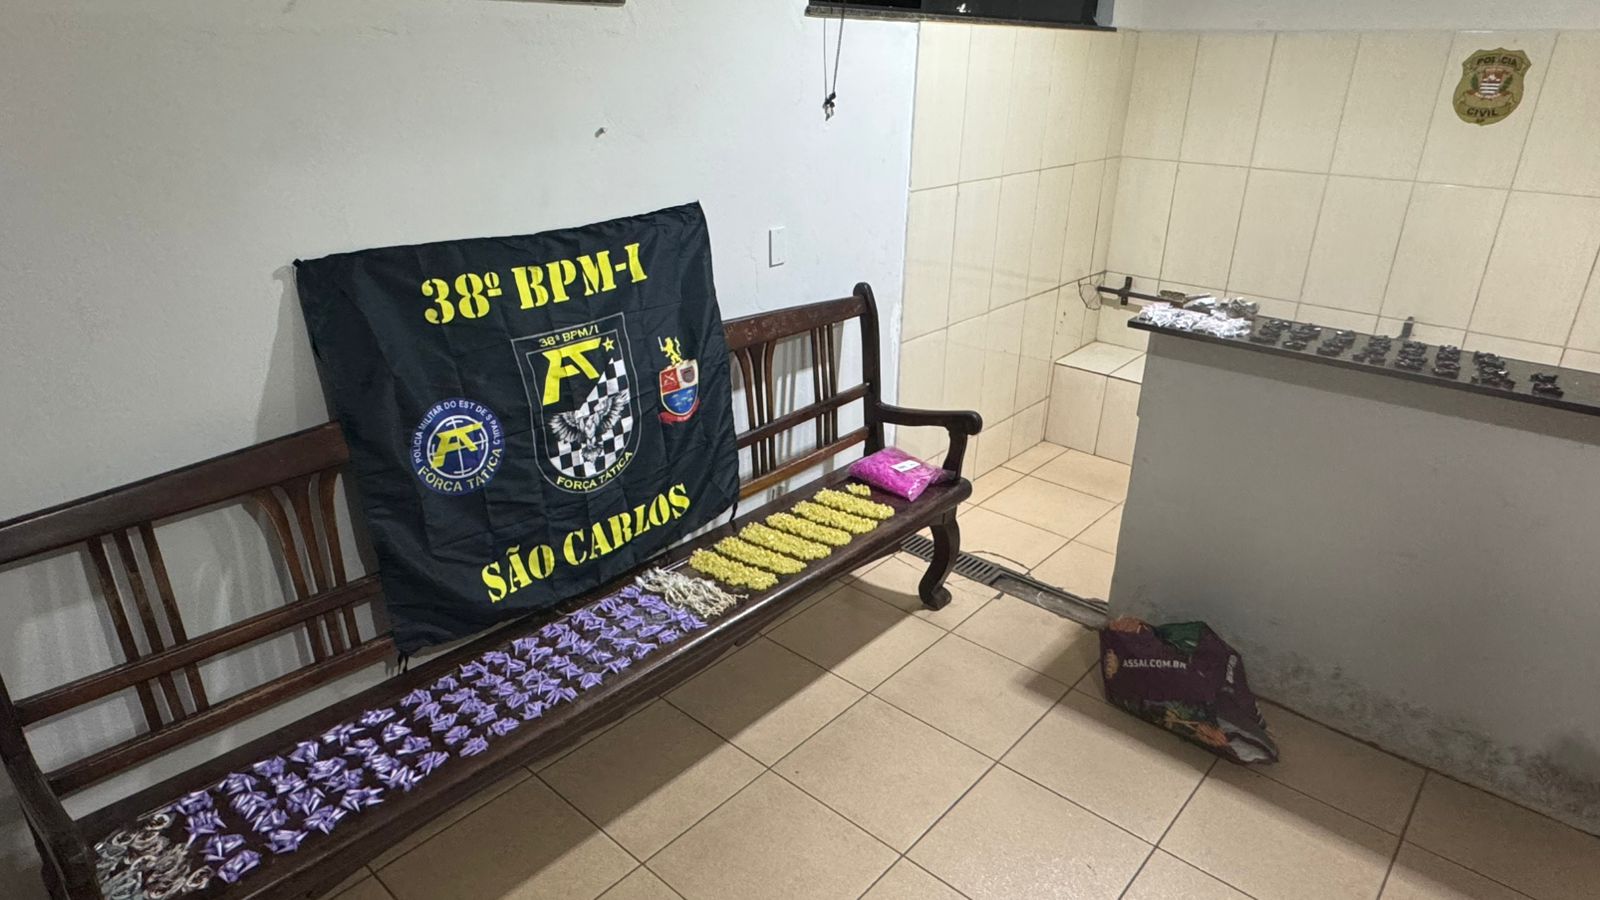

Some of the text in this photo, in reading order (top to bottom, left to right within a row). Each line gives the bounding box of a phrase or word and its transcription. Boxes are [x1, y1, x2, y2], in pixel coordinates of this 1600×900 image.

[1477, 56, 1517, 65] POLCIA
[1467, 107, 1499, 117] CIVIL
[421, 242, 648, 324] 38º BPM-I
[562, 324, 599, 342] BPM/I
[419, 405, 444, 430] MILITAR
[444, 400, 457, 409] DO
[459, 400, 476, 409] EST
[475, 405, 488, 416] DE
[485, 413, 493, 421] S
[466, 448, 502, 490] TATICA
[556, 476, 598, 492] FORÇA
[481, 482, 691, 603] SÃO CARLOS
